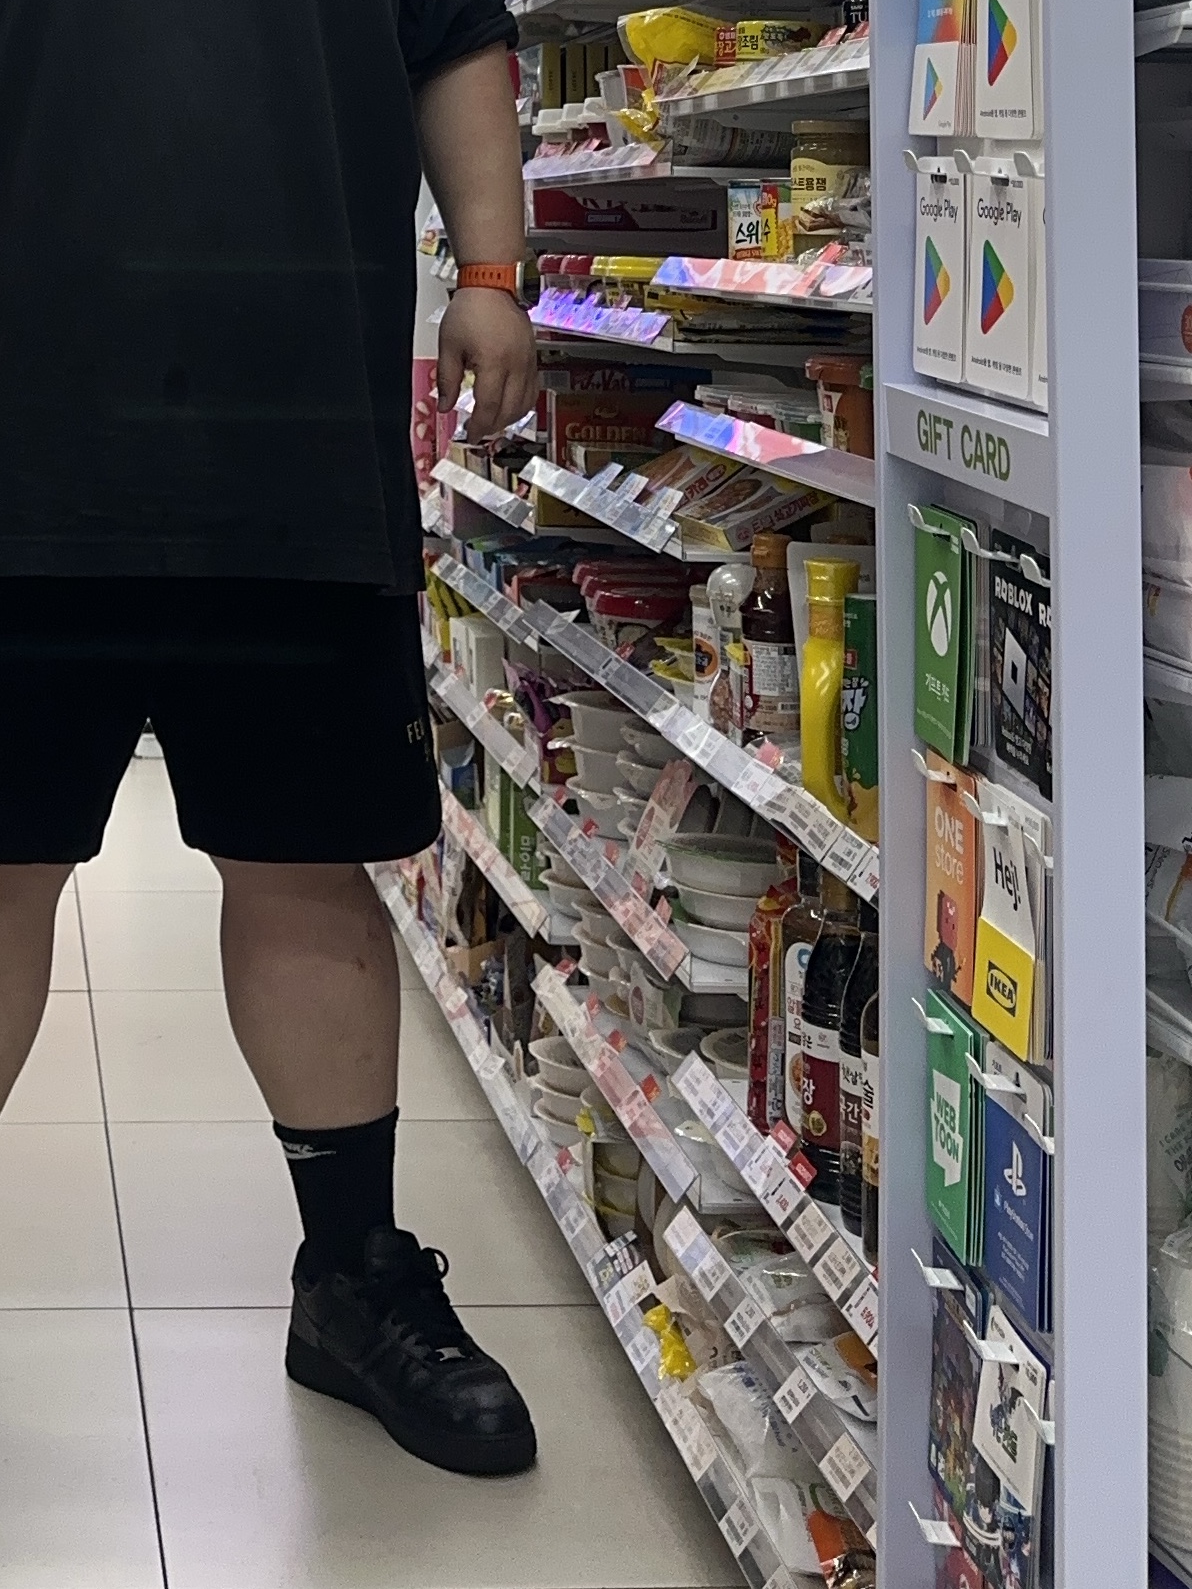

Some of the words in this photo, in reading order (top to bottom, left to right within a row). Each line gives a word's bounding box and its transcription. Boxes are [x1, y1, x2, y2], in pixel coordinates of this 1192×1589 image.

[919, 196, 943, 219] Google
[943, 198, 958, 223] Play
[977, 197, 1004, 226] Google
[1005, 201, 1022, 228] Play
[916, 408, 954, 462] GIFT
[960, 423, 1012, 483] CARD
[994, 575, 1033, 616] ROBLOX
[934, 805, 964, 855] ONE
[935, 841, 964, 886] store
[992, 846, 1021, 912] Hej!
[989, 971, 1015, 1004] IKEA
[935, 1091, 957, 1132] WEB
[934, 1112, 960, 1164] TOON
